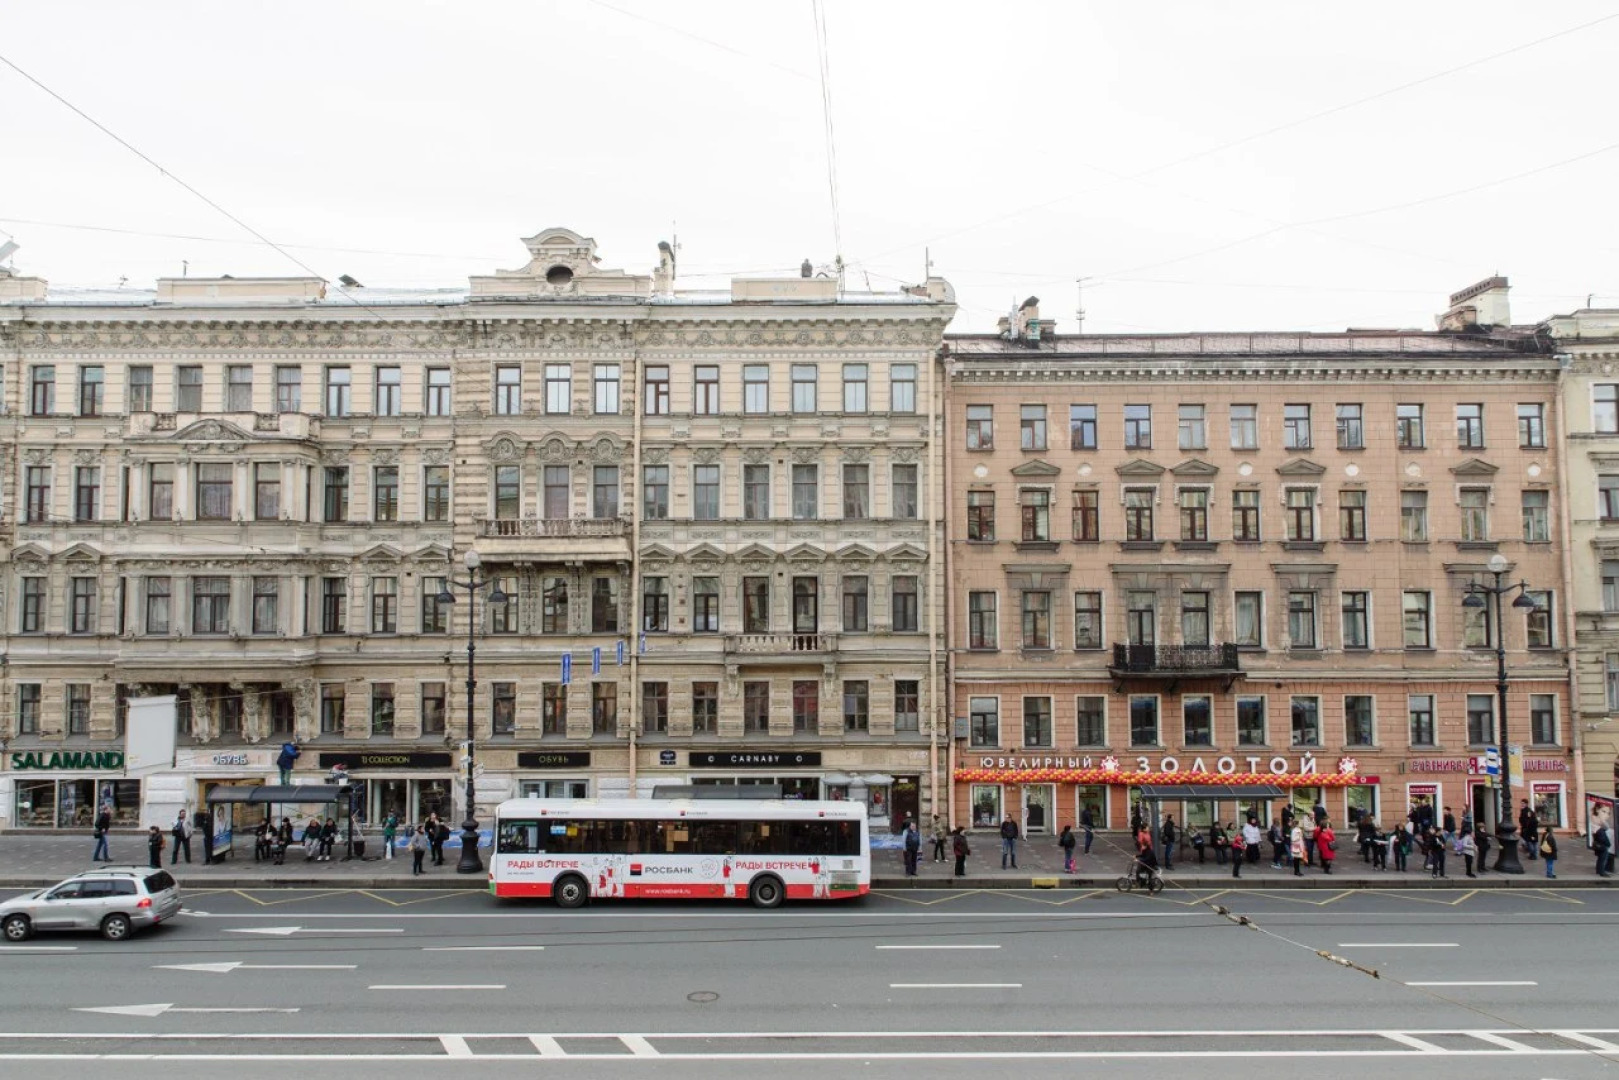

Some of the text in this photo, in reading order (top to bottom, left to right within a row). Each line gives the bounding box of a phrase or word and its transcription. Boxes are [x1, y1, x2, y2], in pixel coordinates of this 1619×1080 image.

[212, 754, 248, 765] ОБУВЬ
[368, 755, 410, 764] COLLECTION
[538, 755, 569, 764] ОБУВЬ
[730, 754, 780, 763] CARNABY
[980, 751, 1317, 775] ЮВЕЛИРНЫЙ ЗОЛОТОЙ
[507, 861, 535, 869] РАДЫ
[735, 862, 808, 870] РАДЫ ВСТРЕЧЕ
[645, 866, 694, 874] РОСБАНК
